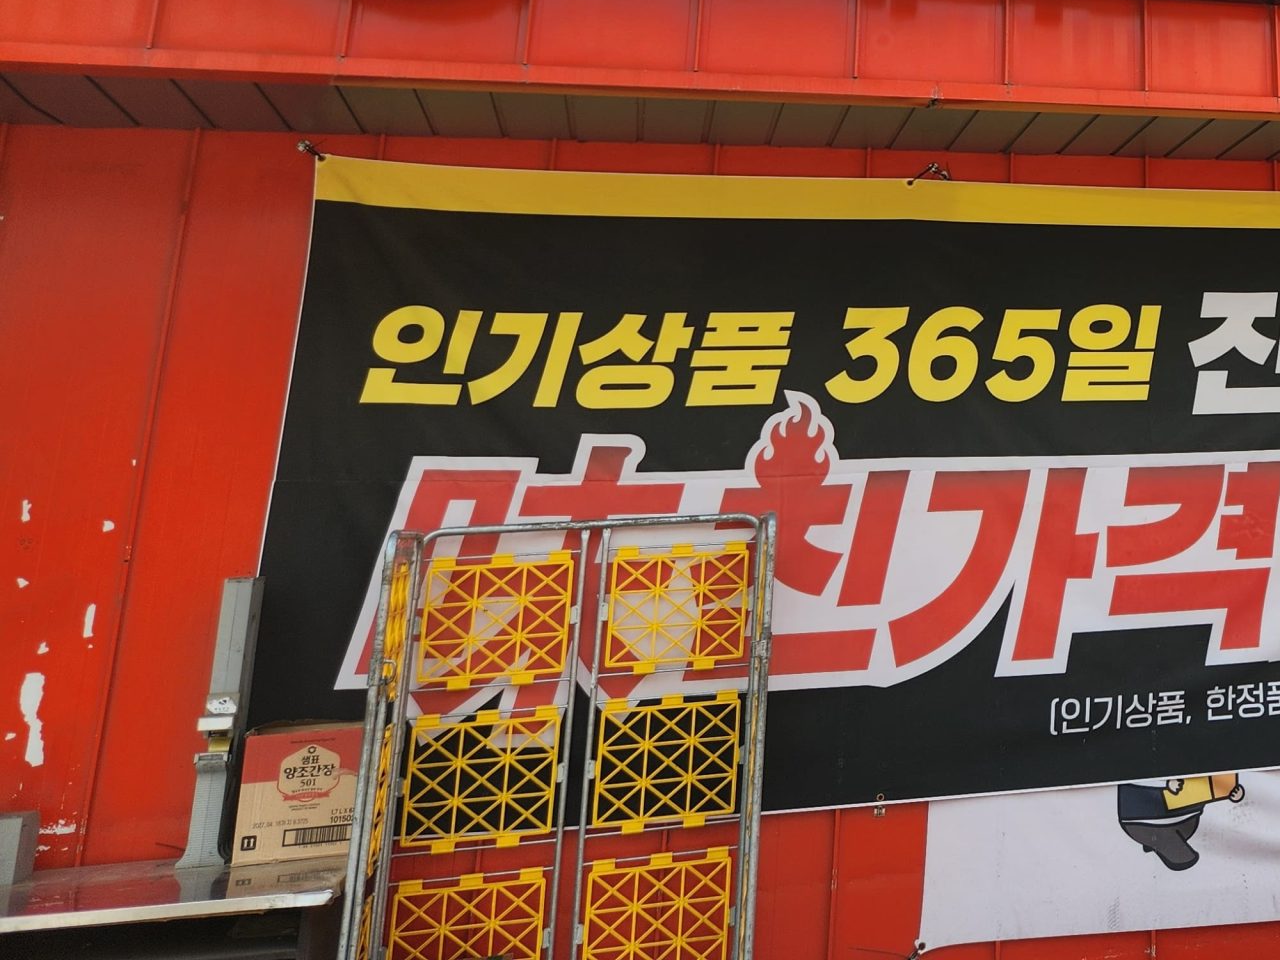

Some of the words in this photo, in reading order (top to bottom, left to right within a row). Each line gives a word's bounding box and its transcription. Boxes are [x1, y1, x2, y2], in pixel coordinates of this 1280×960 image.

[359, 305, 795, 409] 인기상품
[825, 304, 1161, 403] 365일
[301, 755, 321, 765] 샘표
[284, 764, 336, 780] 양조간장
[300, 779, 316, 788] 501
